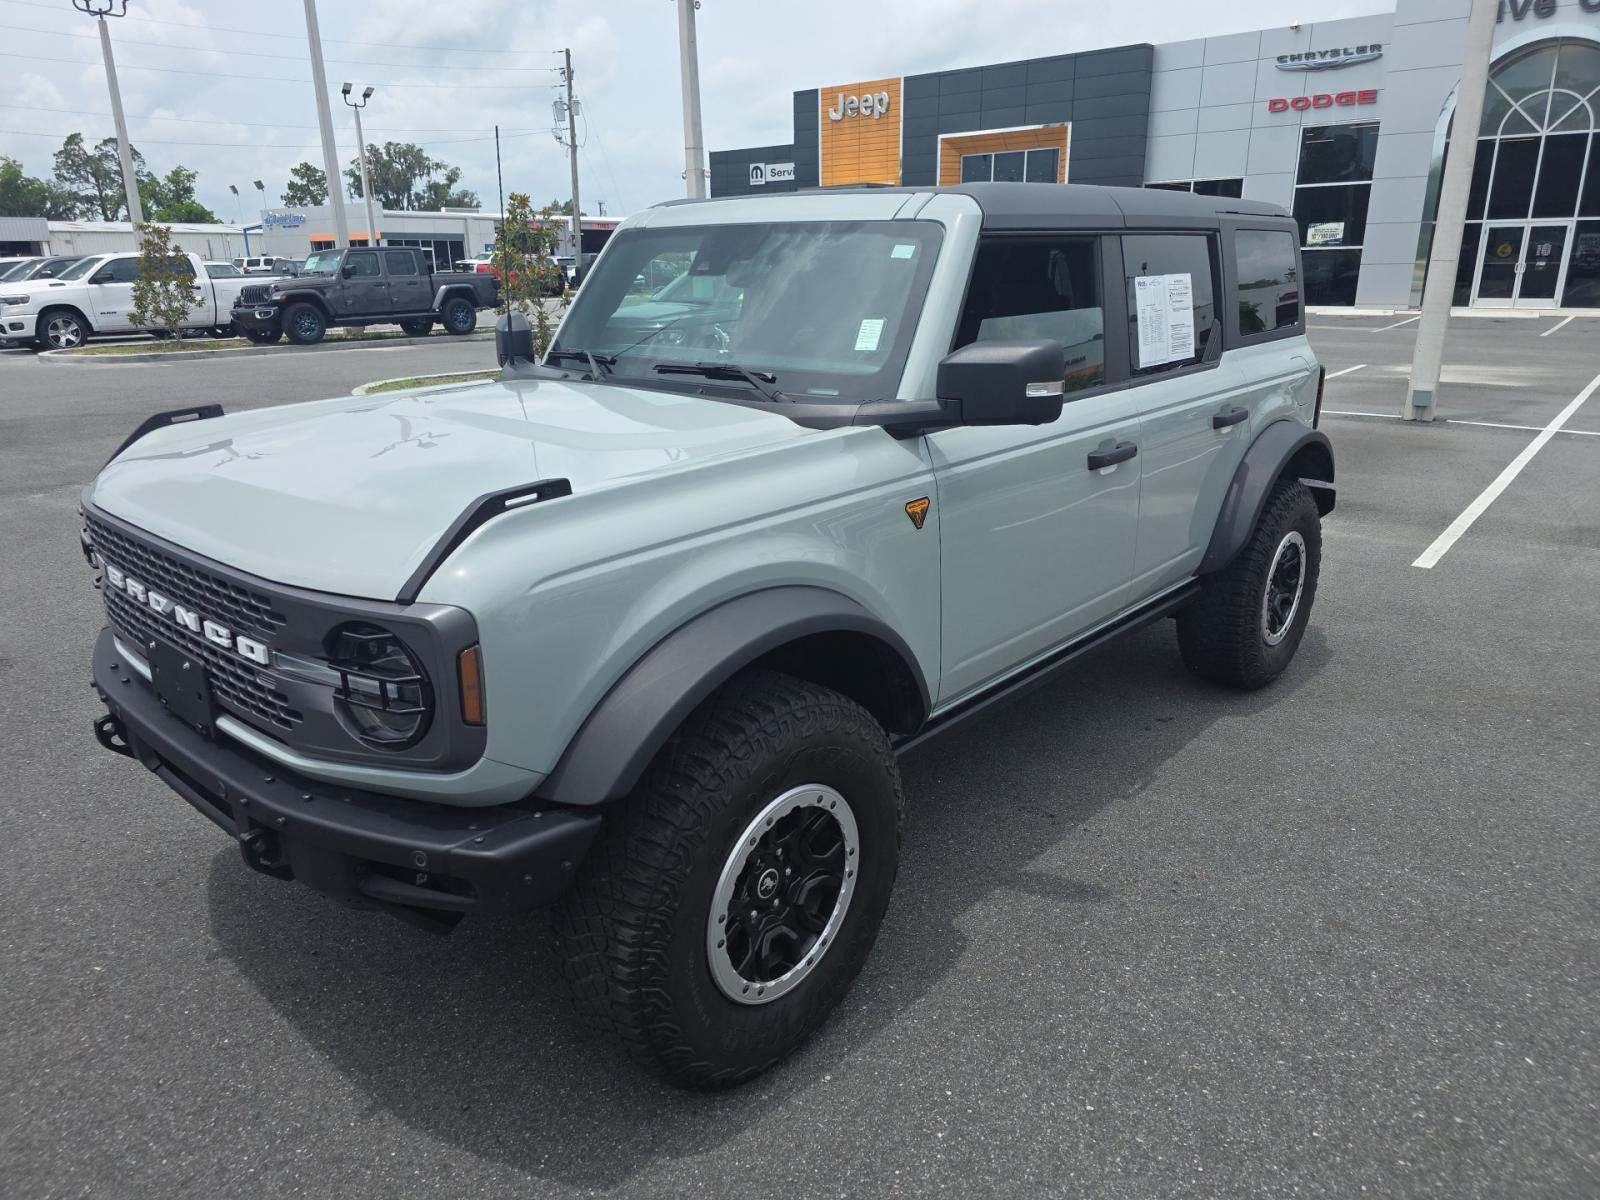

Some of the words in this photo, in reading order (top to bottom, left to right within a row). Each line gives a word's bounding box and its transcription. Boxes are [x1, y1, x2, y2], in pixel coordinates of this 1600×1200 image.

[1277, 44, 1382, 63] CHRYSLER
[828, 91, 889, 120] Jeep
[1268, 89, 1377, 112] DODGE
[106, 565, 270, 665] BRONCO
